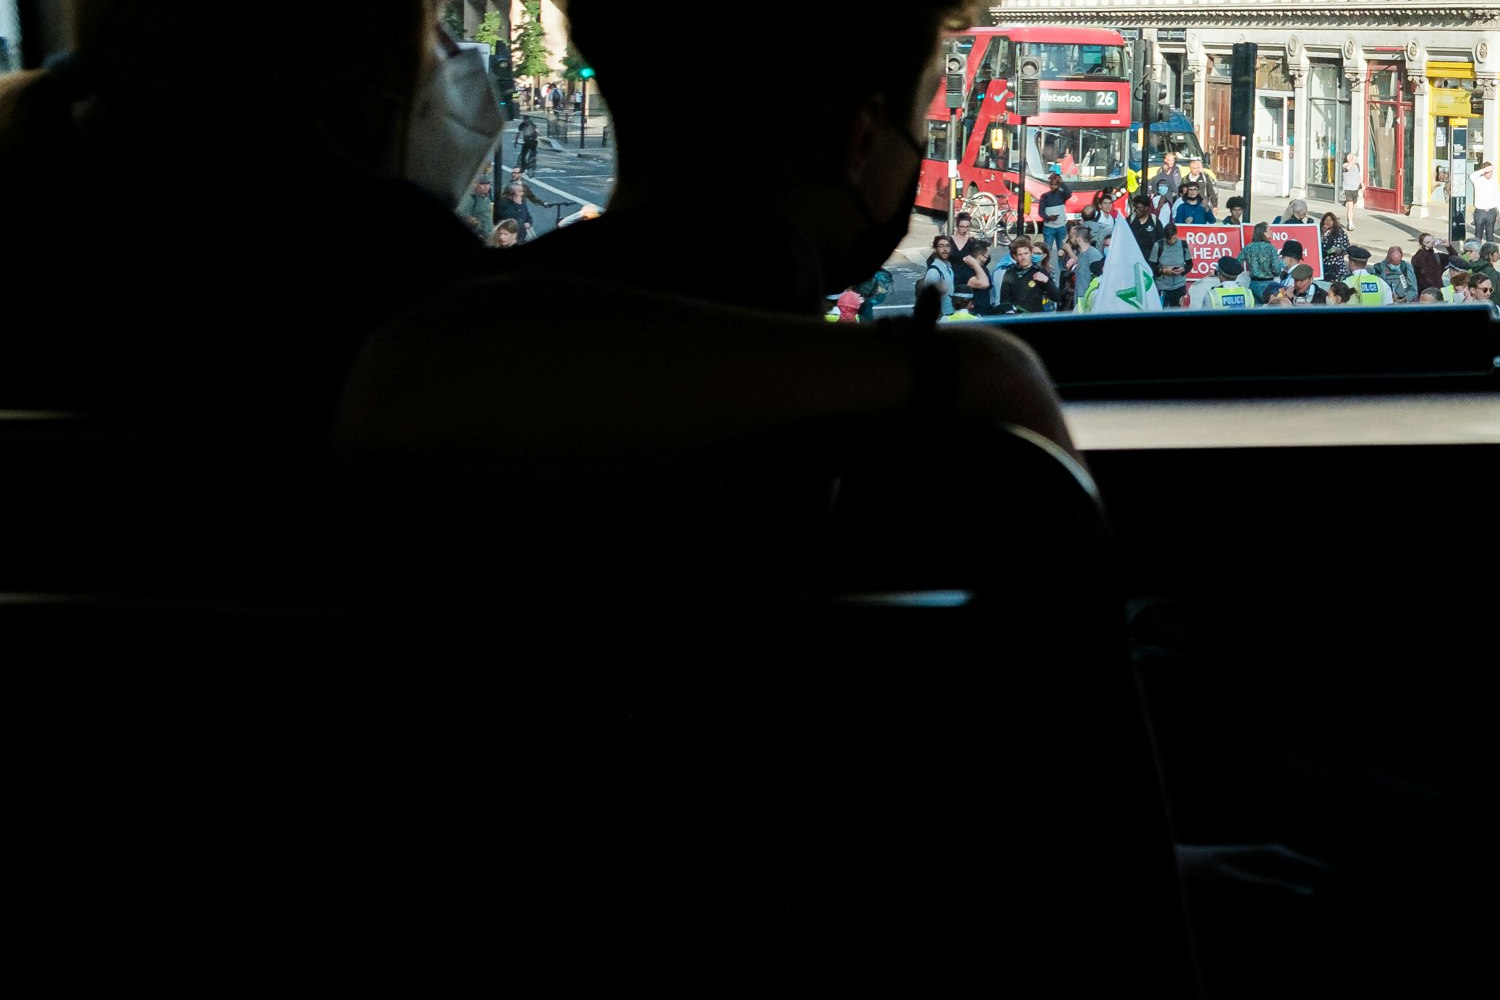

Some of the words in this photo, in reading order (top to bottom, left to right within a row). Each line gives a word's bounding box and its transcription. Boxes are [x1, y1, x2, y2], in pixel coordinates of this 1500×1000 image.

[1096, 91, 1115, 106] 26
[1186, 231, 1228, 245] ROAD
[1272, 231, 1288, 241] NO
[1191, 247, 1232, 260] HEAD
[1222, 295, 1245, 305] POLICE
